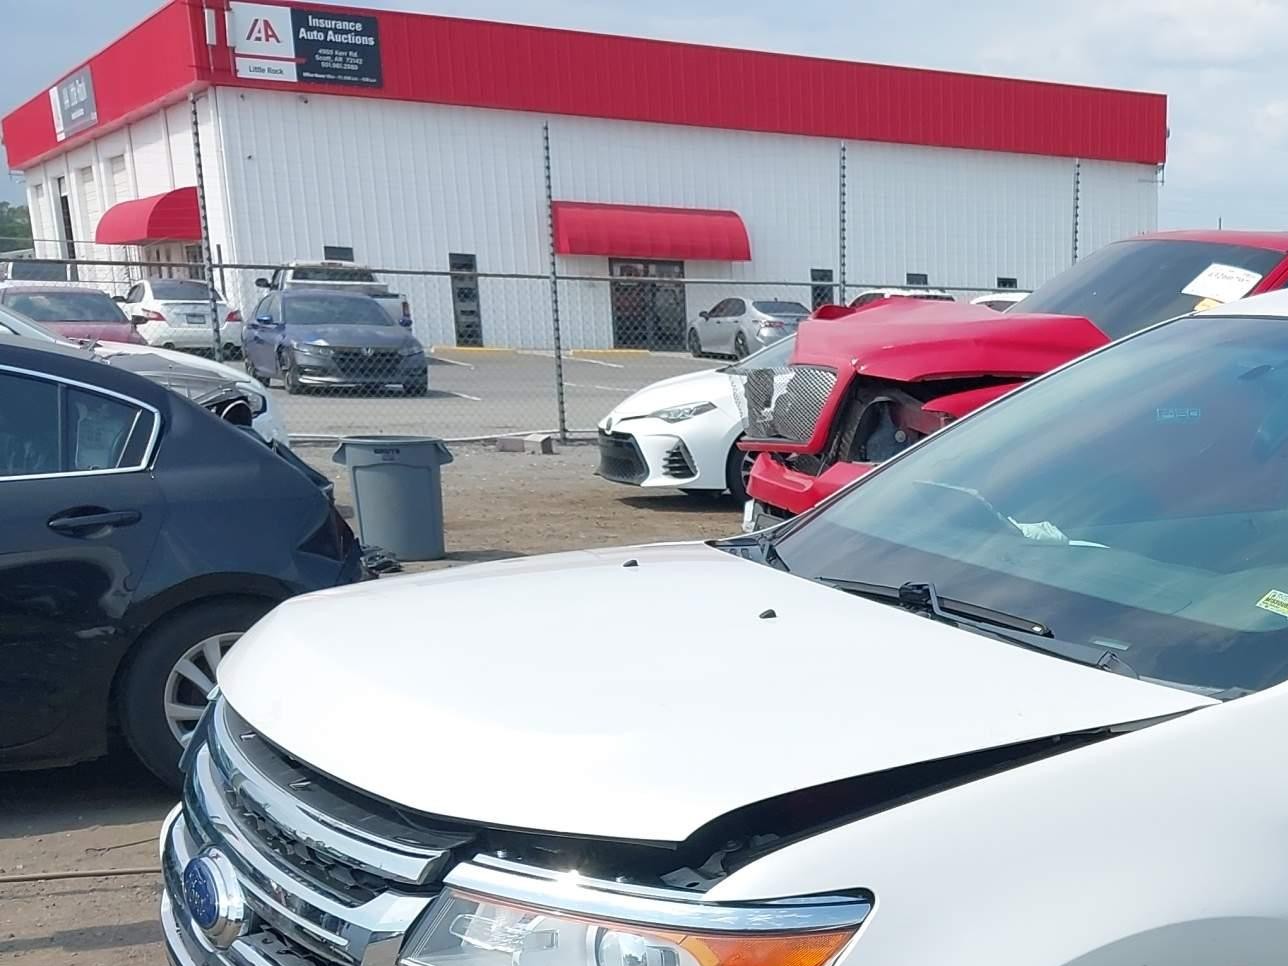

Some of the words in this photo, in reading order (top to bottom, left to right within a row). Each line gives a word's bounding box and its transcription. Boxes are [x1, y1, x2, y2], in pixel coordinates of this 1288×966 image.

[308, 15, 363, 31] Insurance
[298, 28, 324, 41] Auto
[326, 31, 375, 46] Auctions
[249, 65, 266, 73] Little
